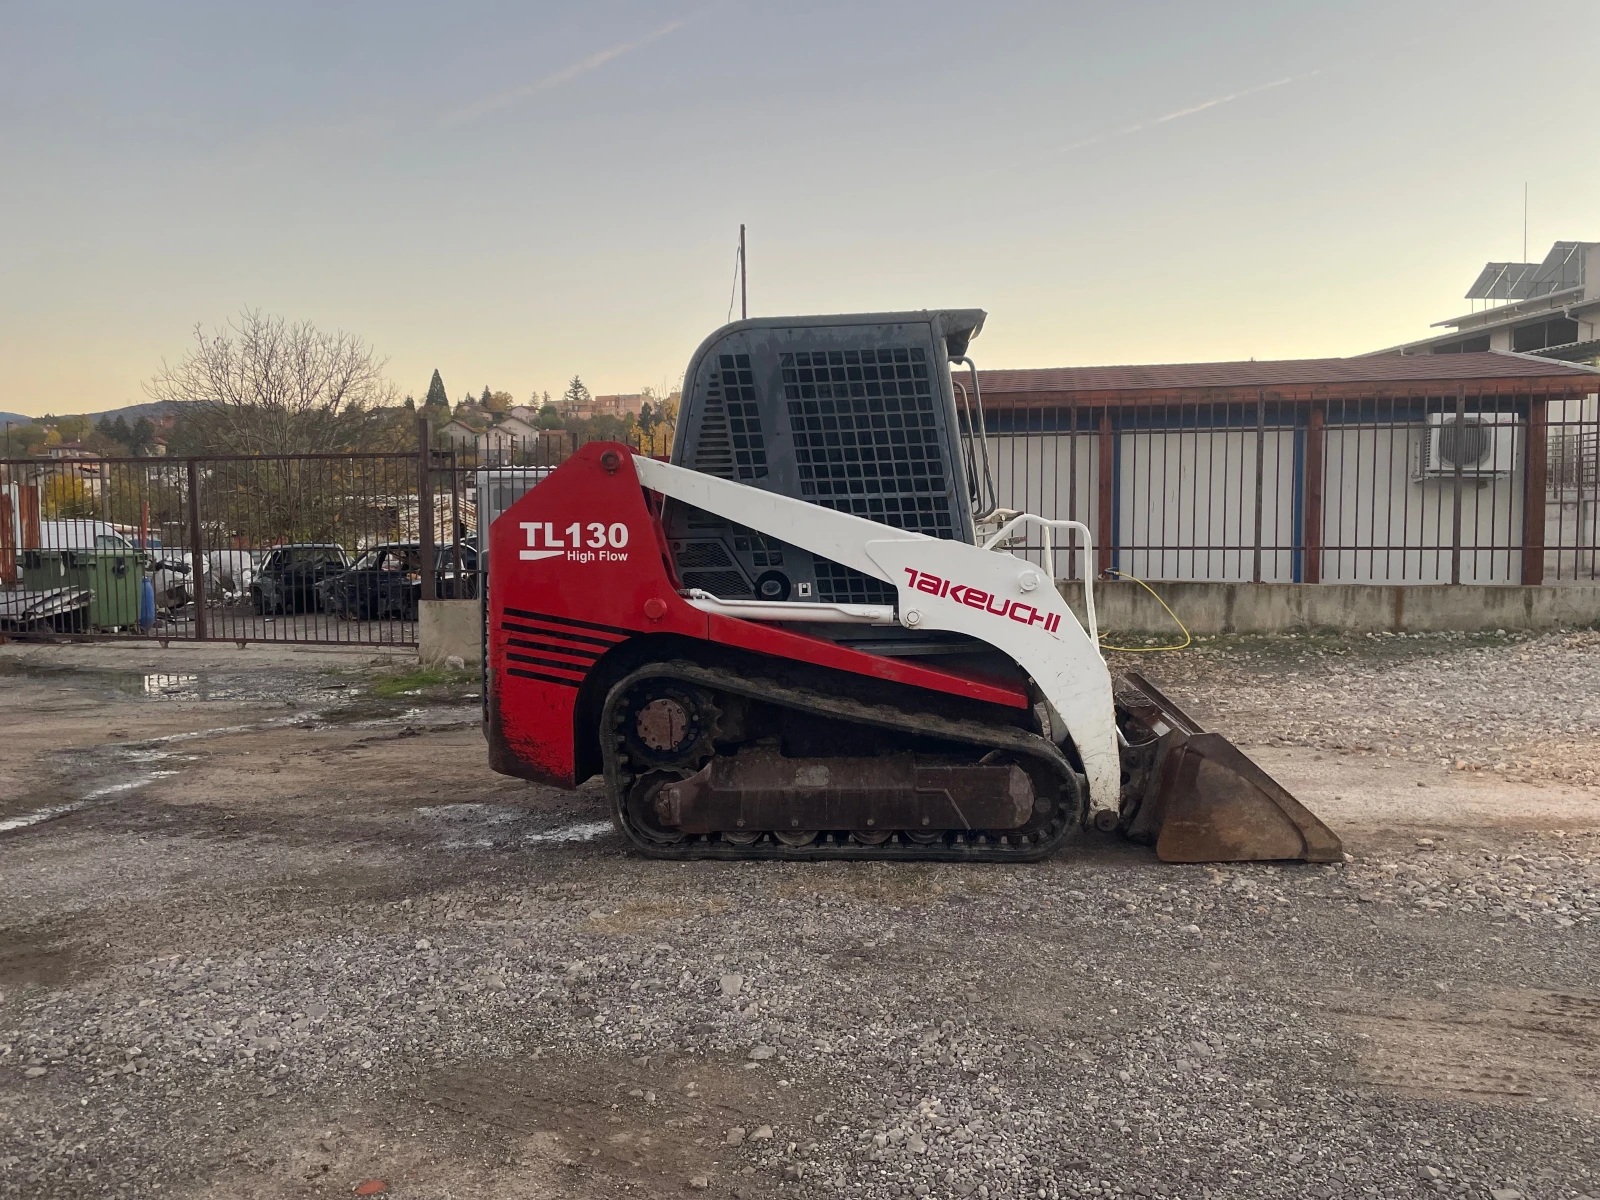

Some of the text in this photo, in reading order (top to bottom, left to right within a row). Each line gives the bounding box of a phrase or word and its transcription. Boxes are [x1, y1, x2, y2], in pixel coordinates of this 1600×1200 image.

[519, 522, 628, 548] TL130
[567, 551, 628, 563] High Flow
